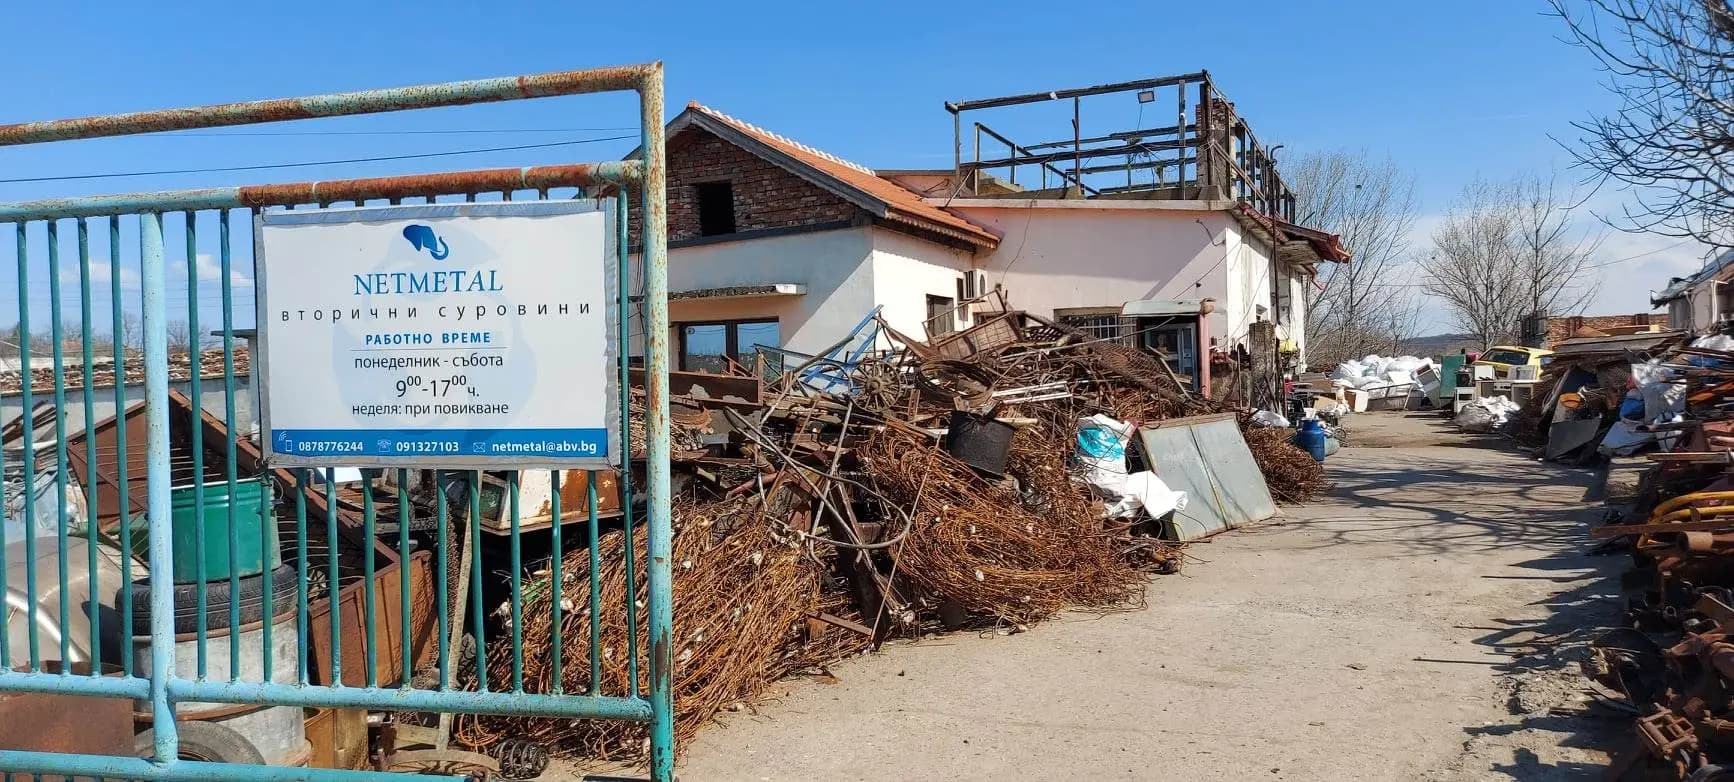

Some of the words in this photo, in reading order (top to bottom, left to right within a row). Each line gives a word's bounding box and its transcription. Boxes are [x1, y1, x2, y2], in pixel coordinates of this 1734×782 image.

[354, 270, 503, 295] NETMETAL
[281, 307, 418, 322] вторични
[439, 302, 590, 319] суровини
[365, 334, 433, 346] РАБОТНО
[441, 332, 491, 345] ВРЕМЕ
[354, 356, 440, 369] понеделник
[452, 353, 503, 368] събота
[352, 404, 402, 416] неделя:
[405, 405, 431, 417] при
[434, 402, 509, 415] повикване
[298, 441, 364, 453] 0878776244
[396, 441, 459, 453] 091327103
[492, 441, 597, 454] netmetal@abv.bg
